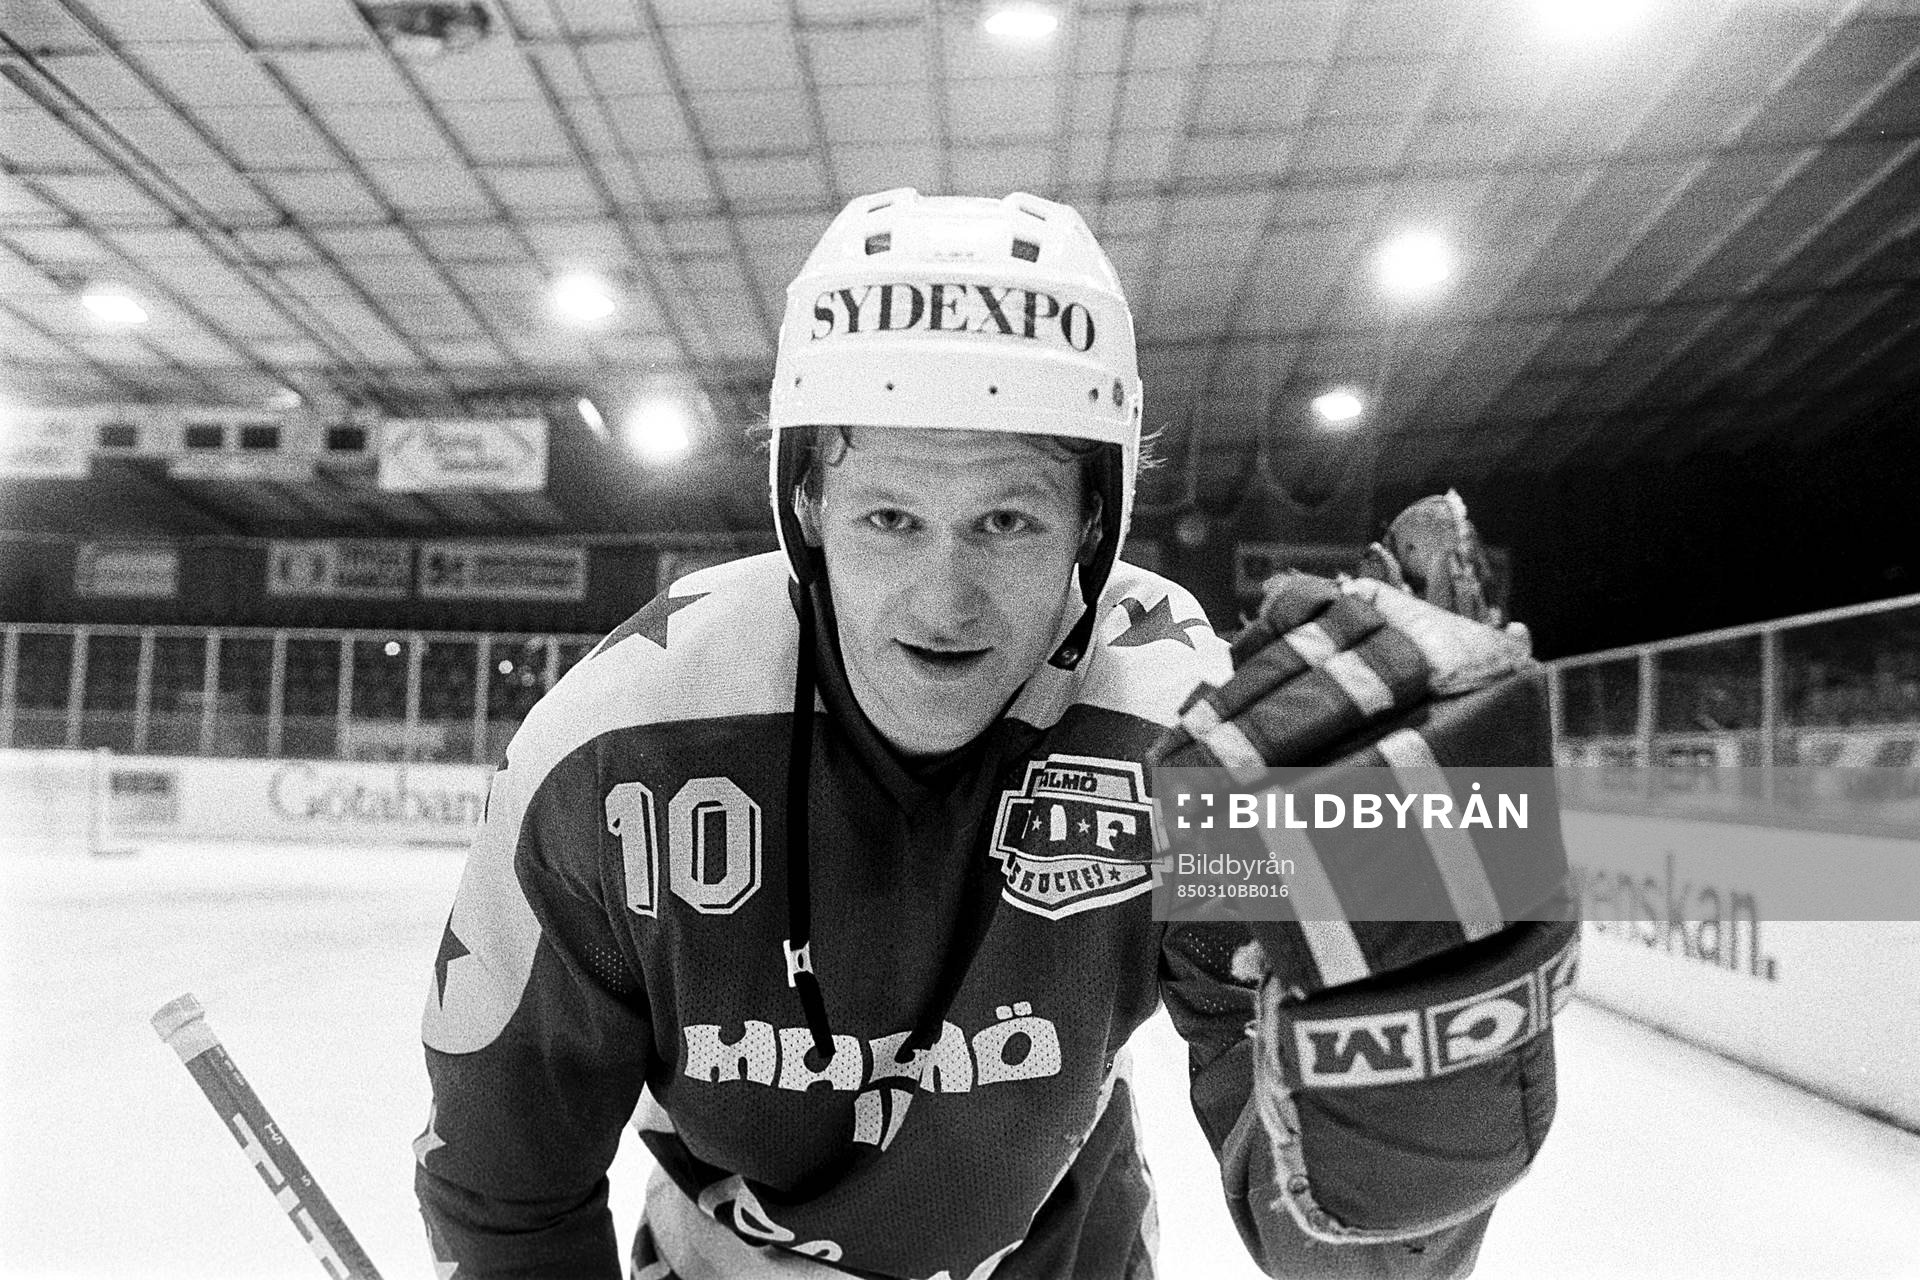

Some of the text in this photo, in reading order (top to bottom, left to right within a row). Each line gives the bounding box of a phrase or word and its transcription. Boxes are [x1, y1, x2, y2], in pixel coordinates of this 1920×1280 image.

[810, 282, 1095, 352] SYDEXPO
[1040, 770, 1098, 793] ALMÖ
[604, 777, 762, 918] 10
